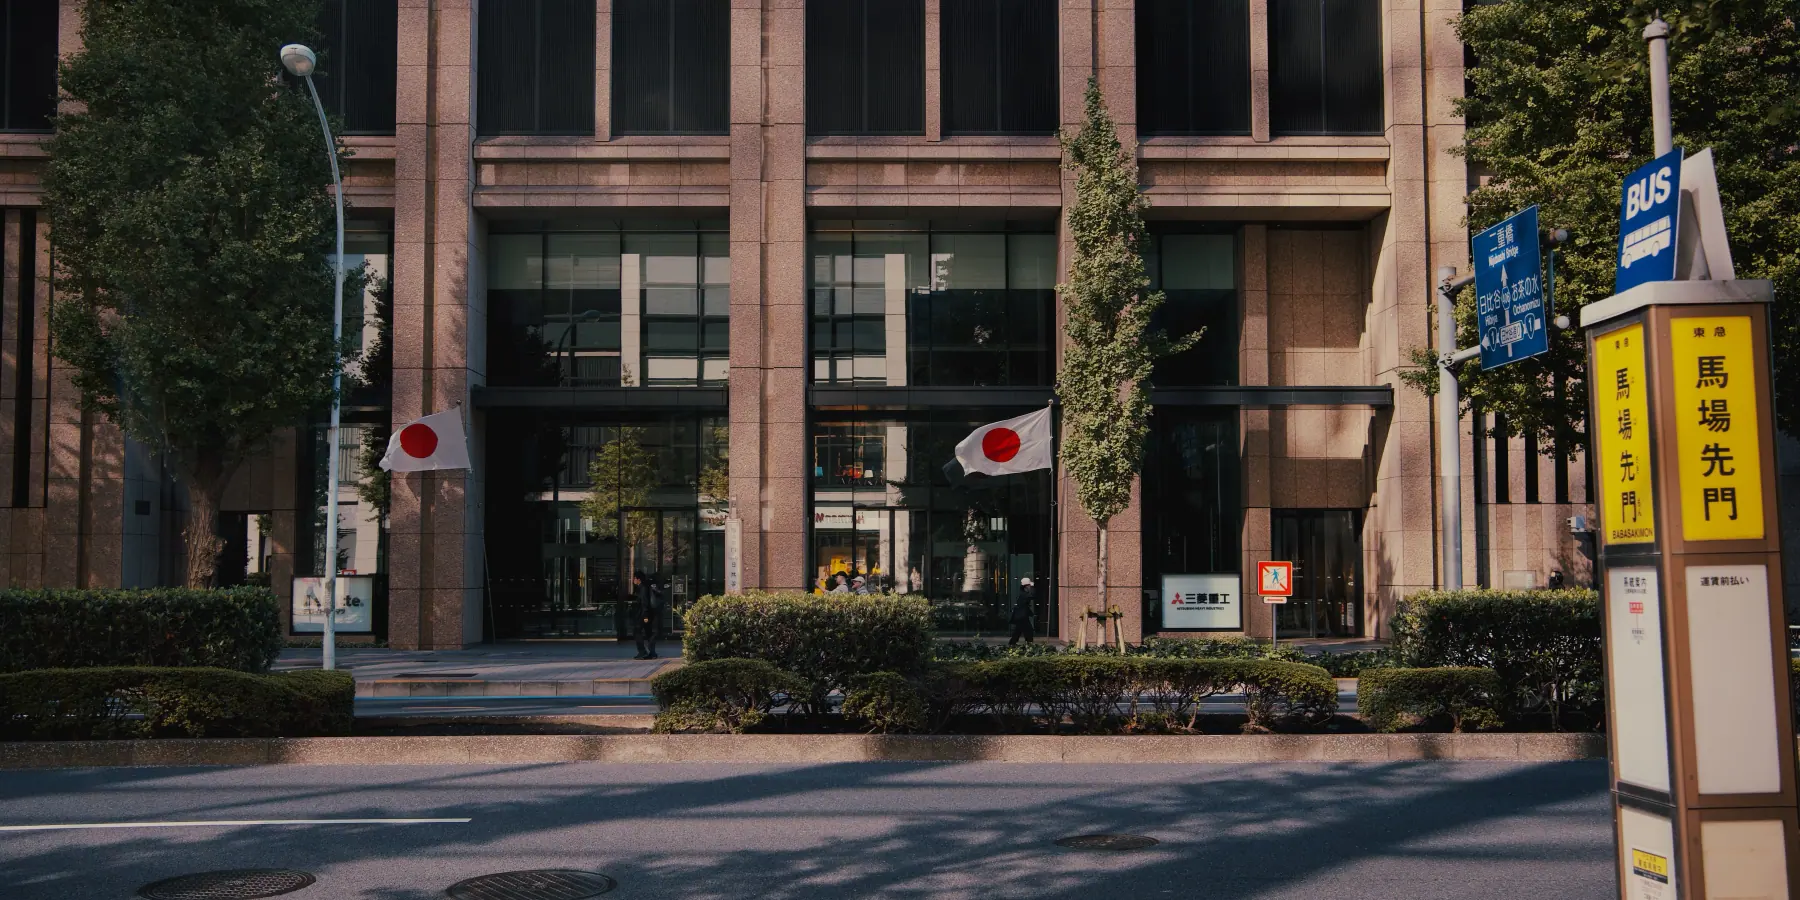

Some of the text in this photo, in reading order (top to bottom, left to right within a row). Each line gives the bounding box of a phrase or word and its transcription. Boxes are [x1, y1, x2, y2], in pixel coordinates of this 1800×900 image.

[1626, 166, 1671, 220] BUS
[1489, 224, 1514, 252] 二重橋
[1506, 246, 1518, 260] Bridge
[1511, 273, 1540, 302] お茶の水
[1480, 290, 1501, 315] 日比谷
[1513, 298, 1540, 316] Ochanomizu
[1693, 326, 1726, 338] 東急
[1616, 367, 1637, 524] 馬場先門
[1695, 355, 1738, 521] 馬場先門
[1612, 527, 1653, 539] BABASAKIMON
[1700, 576, 1750, 587] 運賃前払い
[1185, 593, 1230, 604] 三菱重工
